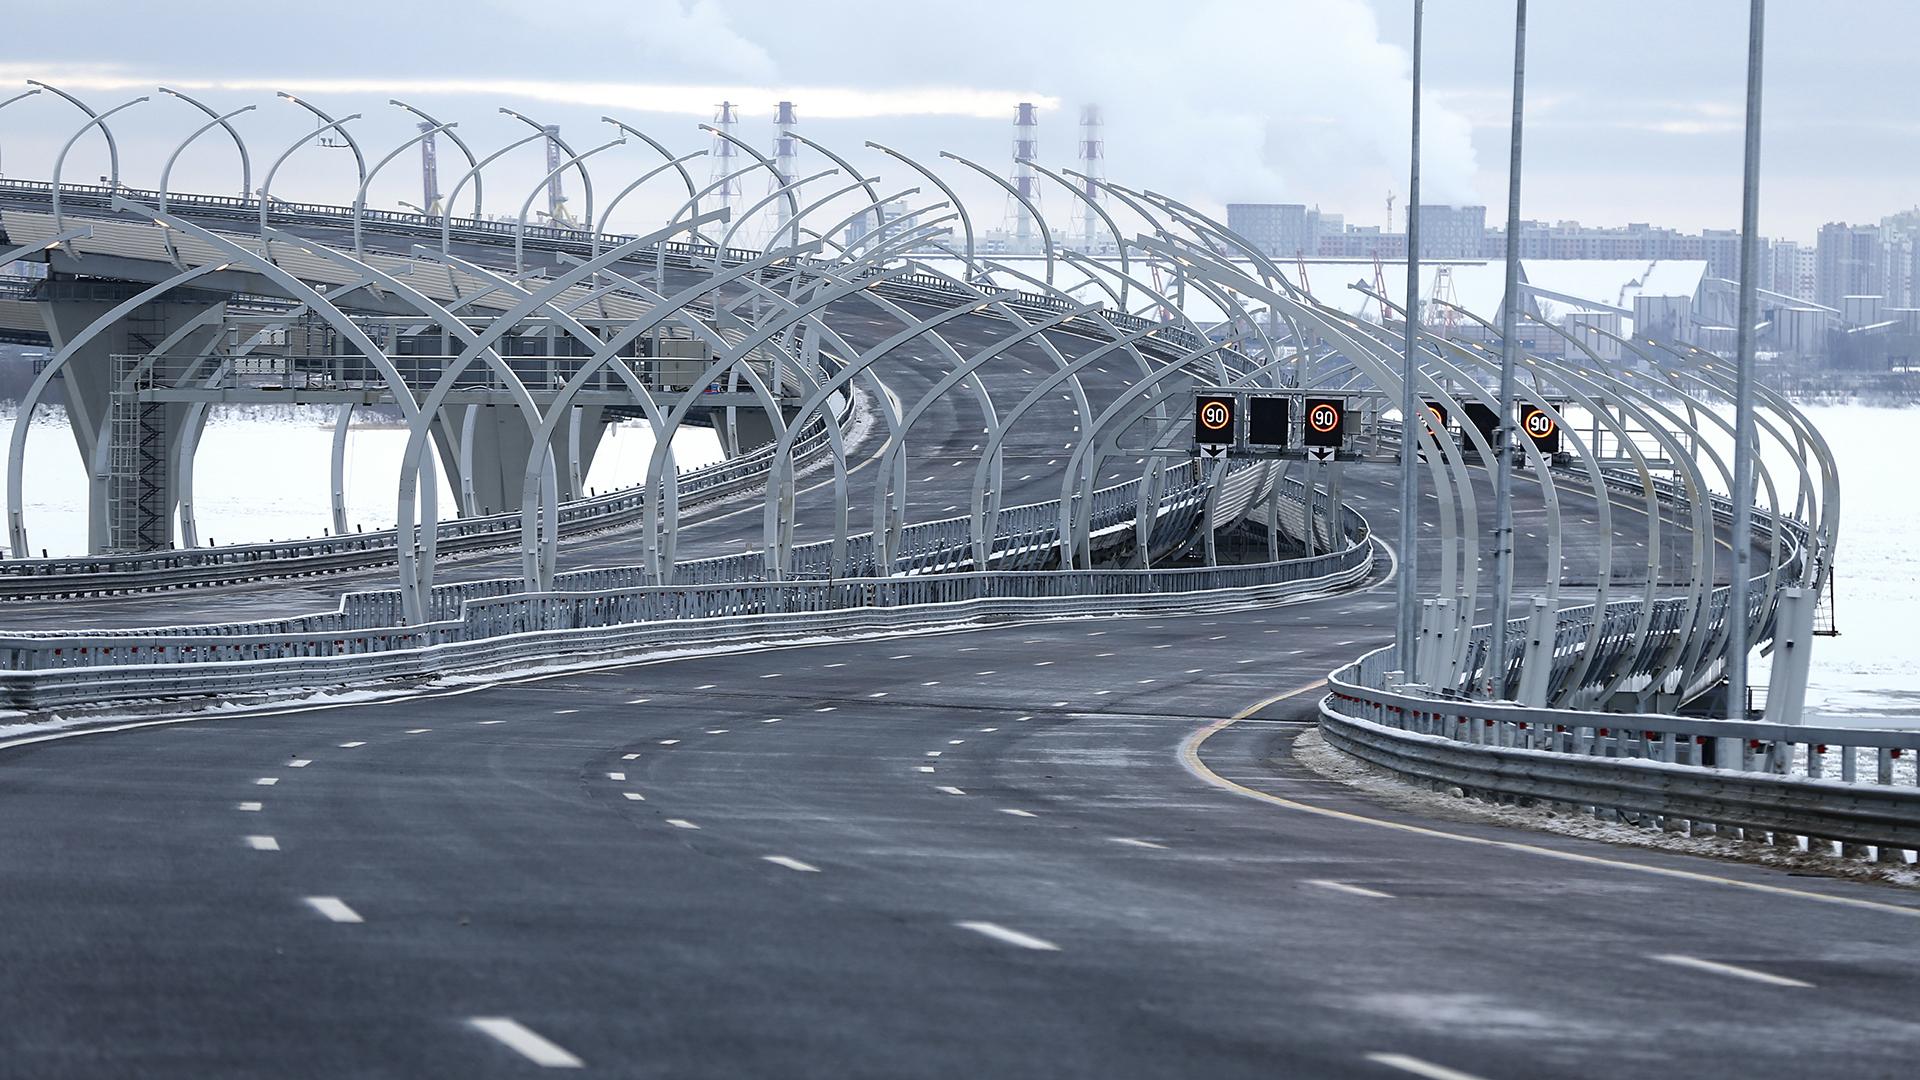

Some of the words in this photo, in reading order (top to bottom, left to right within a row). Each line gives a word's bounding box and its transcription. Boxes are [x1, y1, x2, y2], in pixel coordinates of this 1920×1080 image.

[1206, 408, 1224, 423] 90
[1315, 410, 1333, 426] 90
[1530, 416, 1549, 432] 90
